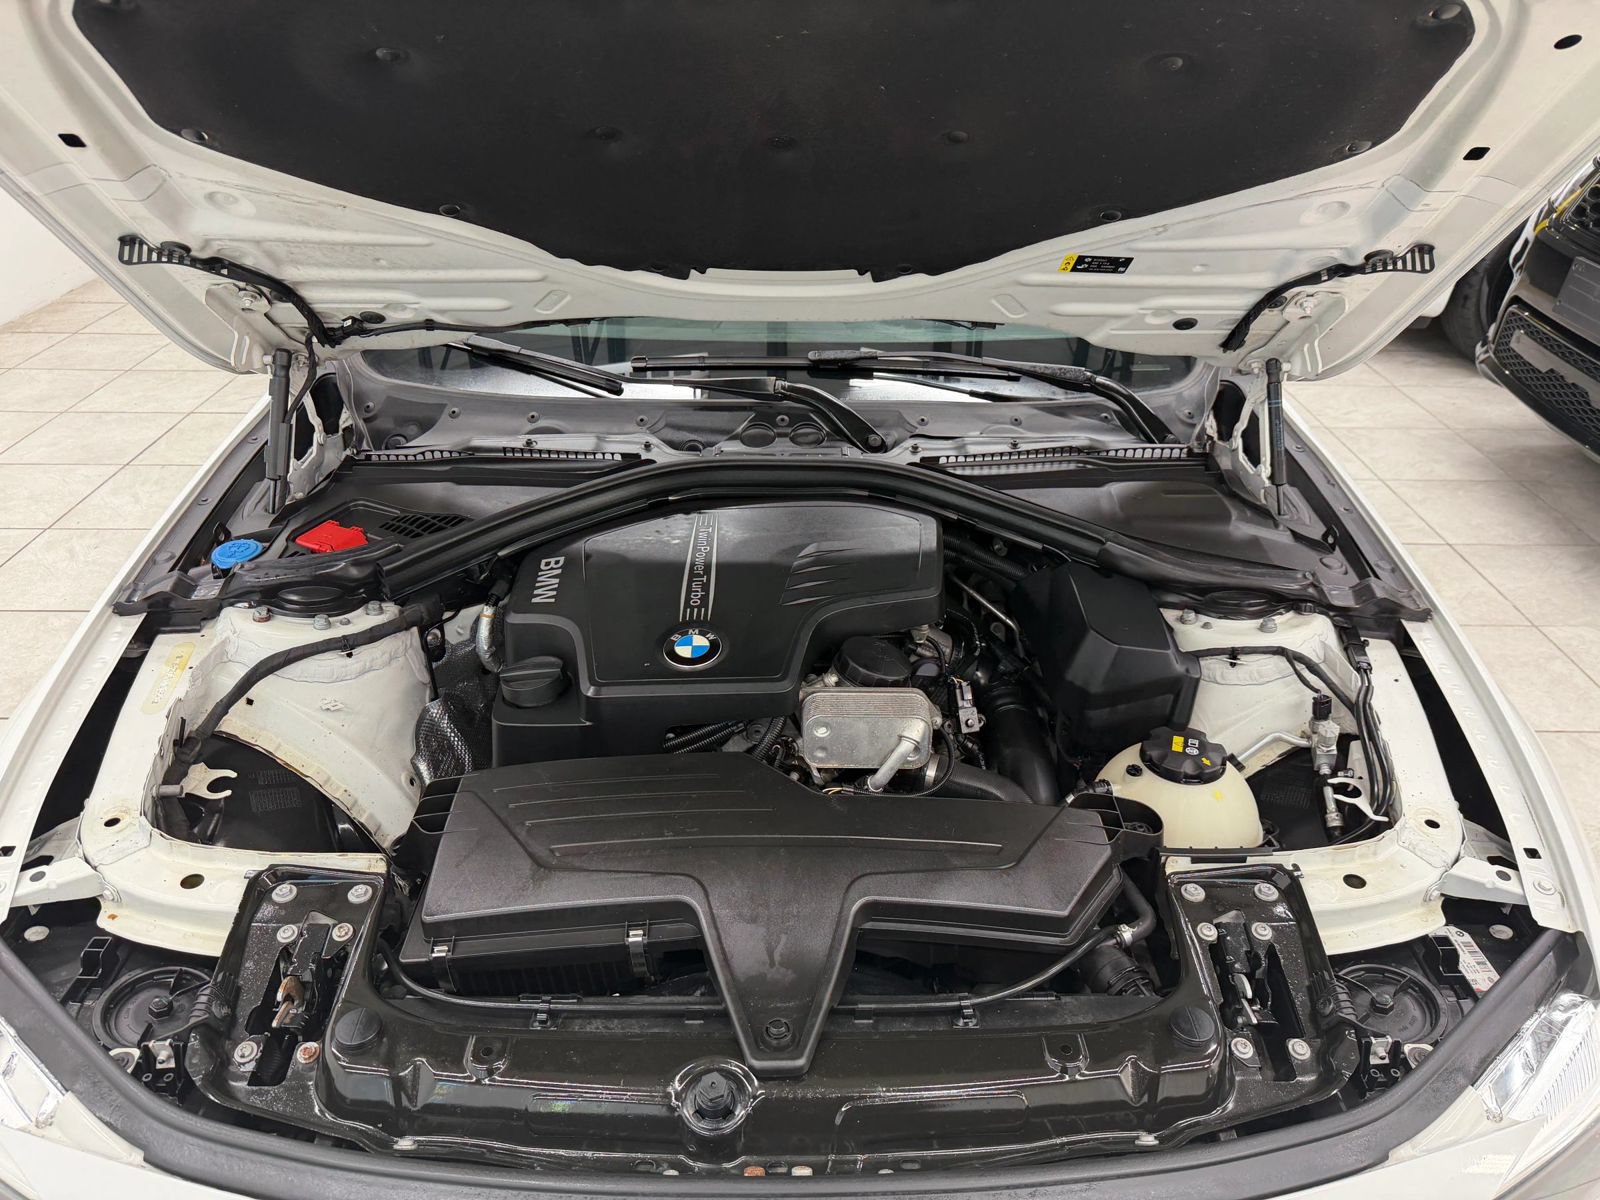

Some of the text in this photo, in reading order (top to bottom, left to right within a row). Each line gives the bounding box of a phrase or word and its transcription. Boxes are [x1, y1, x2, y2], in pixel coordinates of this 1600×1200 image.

[531, 556, 565, 603] BMW
[690, 527, 713, 606] TwinPower Turbo
[670, 628, 717, 641] BMW
